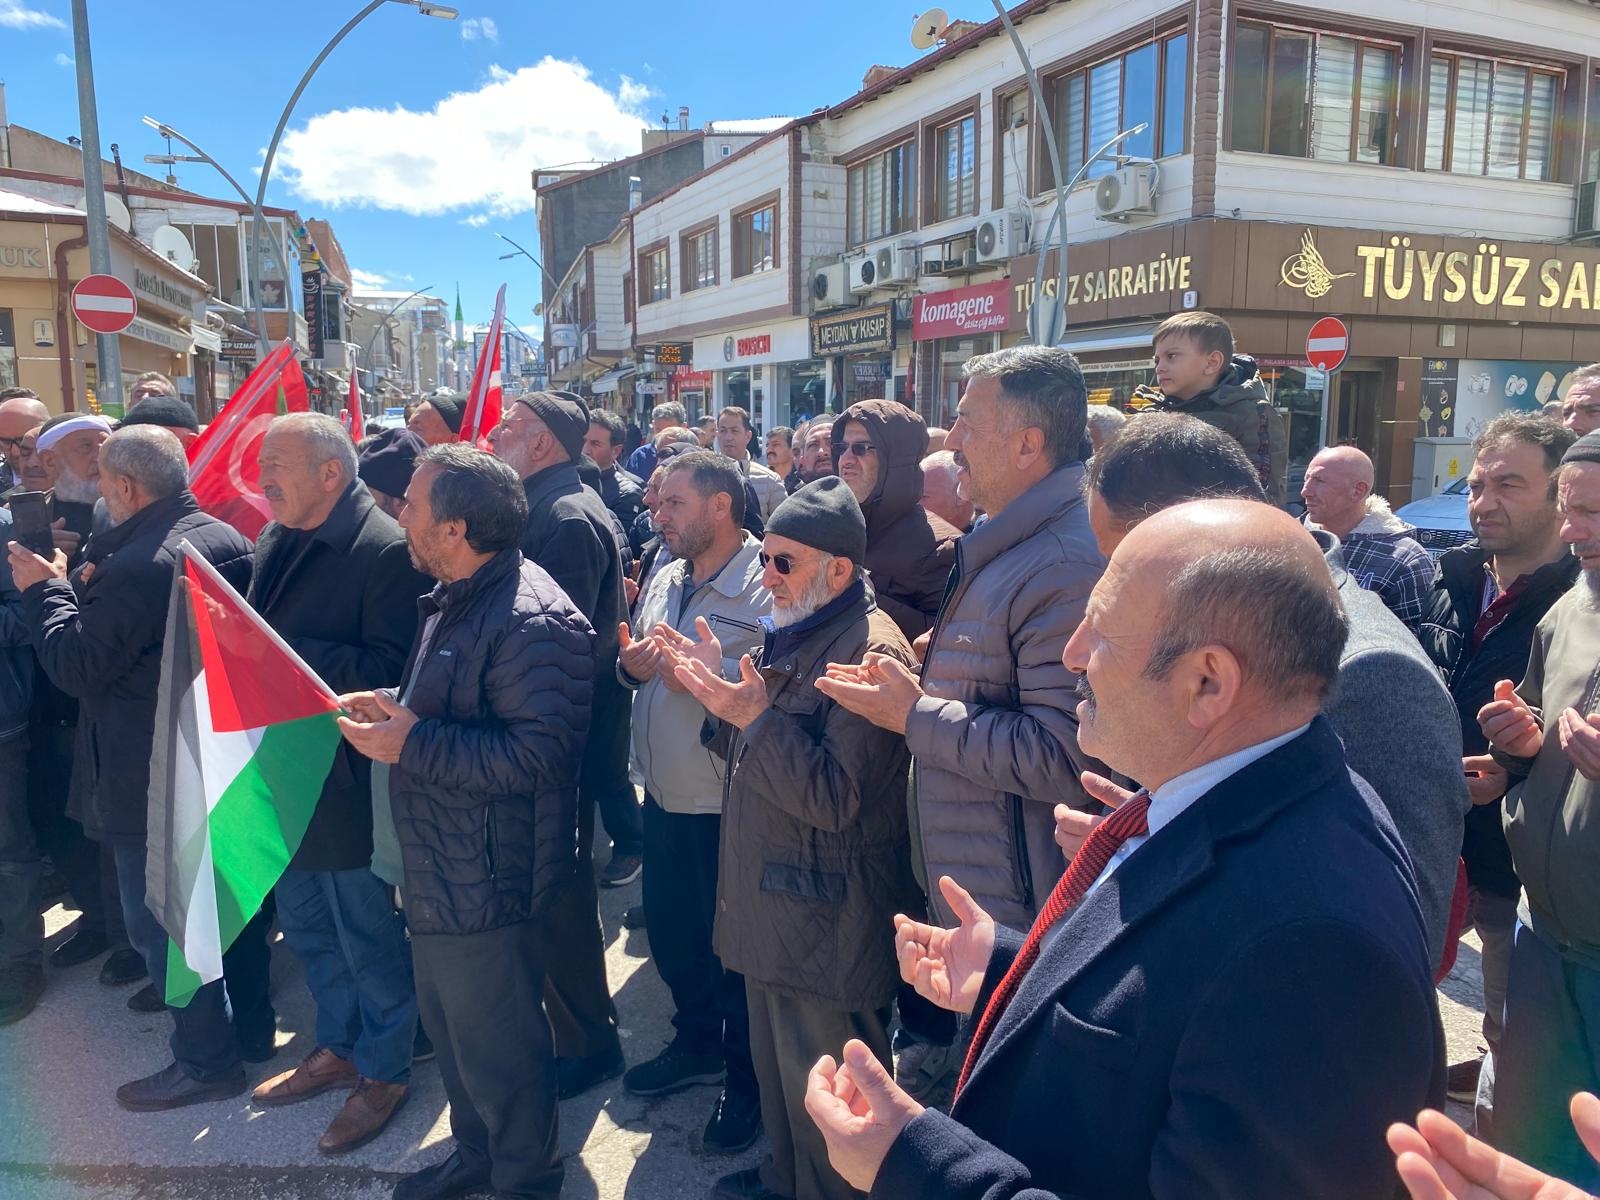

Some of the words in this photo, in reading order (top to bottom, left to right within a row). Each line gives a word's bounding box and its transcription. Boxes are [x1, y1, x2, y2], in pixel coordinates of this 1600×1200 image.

[1083, 252, 1191, 303] SARRAFİYE
[1357, 235, 1531, 307] TÜYSÜZ
[1538, 258, 1600, 311] SA
[920, 295, 994, 326] komagene
[737, 335, 771, 356] BOSCH
[821, 324, 849, 345] MEYDAN
[860, 317, 885, 339] KASAP
